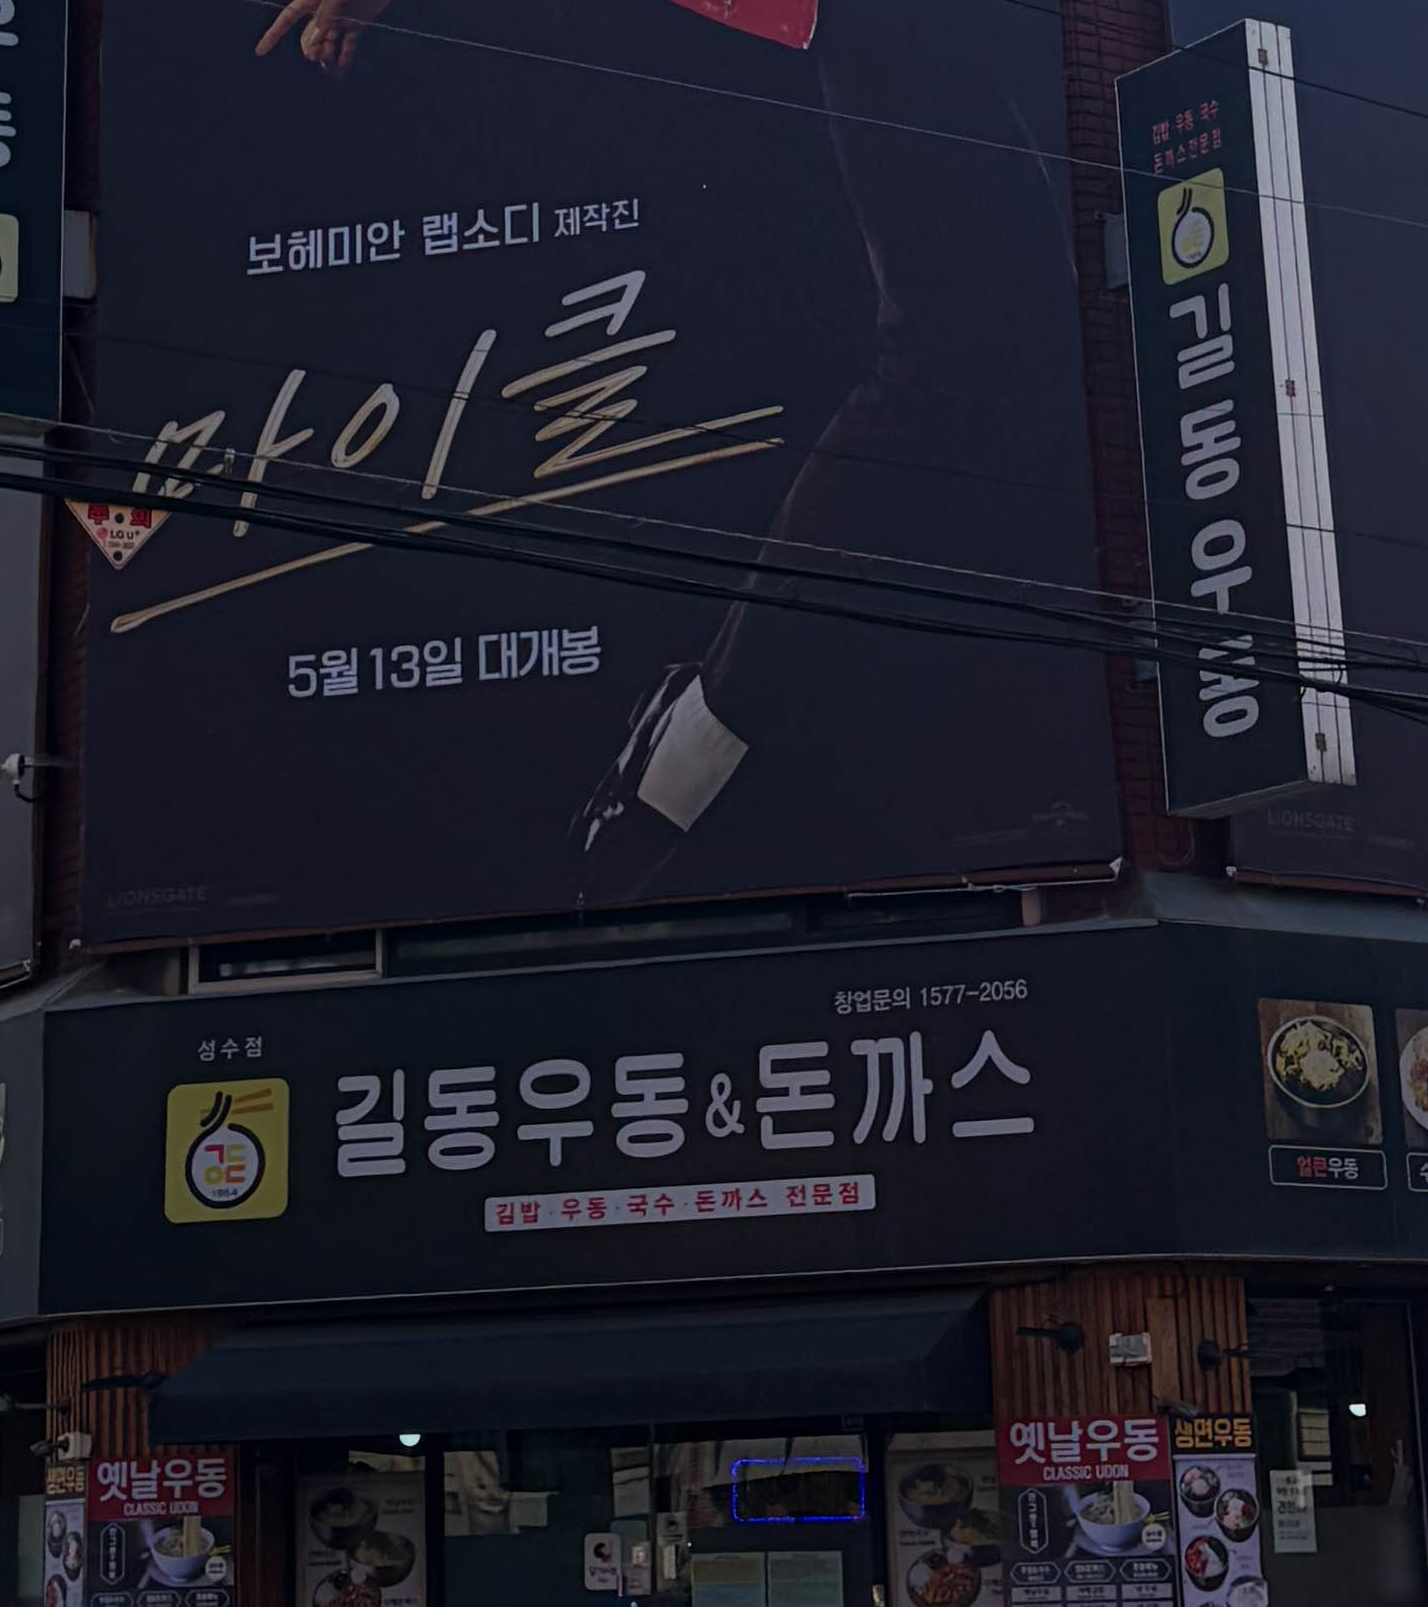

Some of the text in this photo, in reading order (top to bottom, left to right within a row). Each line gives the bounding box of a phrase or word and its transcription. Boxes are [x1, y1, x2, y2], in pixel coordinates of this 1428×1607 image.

[245, 197, 642, 277] 보헤미안 랩소디 제작진
[131, 269, 785, 538] 마이클
[1169, 280, 1262, 740] 길동우동
[286, 624, 604, 699] 5월 13일 대개봉
[833, 977, 1029, 1015] 창업문의 1577-2056
[196, 1034, 266, 1062] 성수점
[335, 1028, 1036, 1179] 길동우동&돈까스
[495, 1181, 861, 1227] 김밥 우동 국수 돈까스 전문점
[1009, 1418, 1160, 1466] 옛날우동
[1174, 1416, 1253, 1450] 생면우동
[96, 1457, 228, 1503] 옛날우동
[1043, 1463, 1129, 1482] CLASSIC UDON
[123, 1500, 168, 1517] CLASSIC
